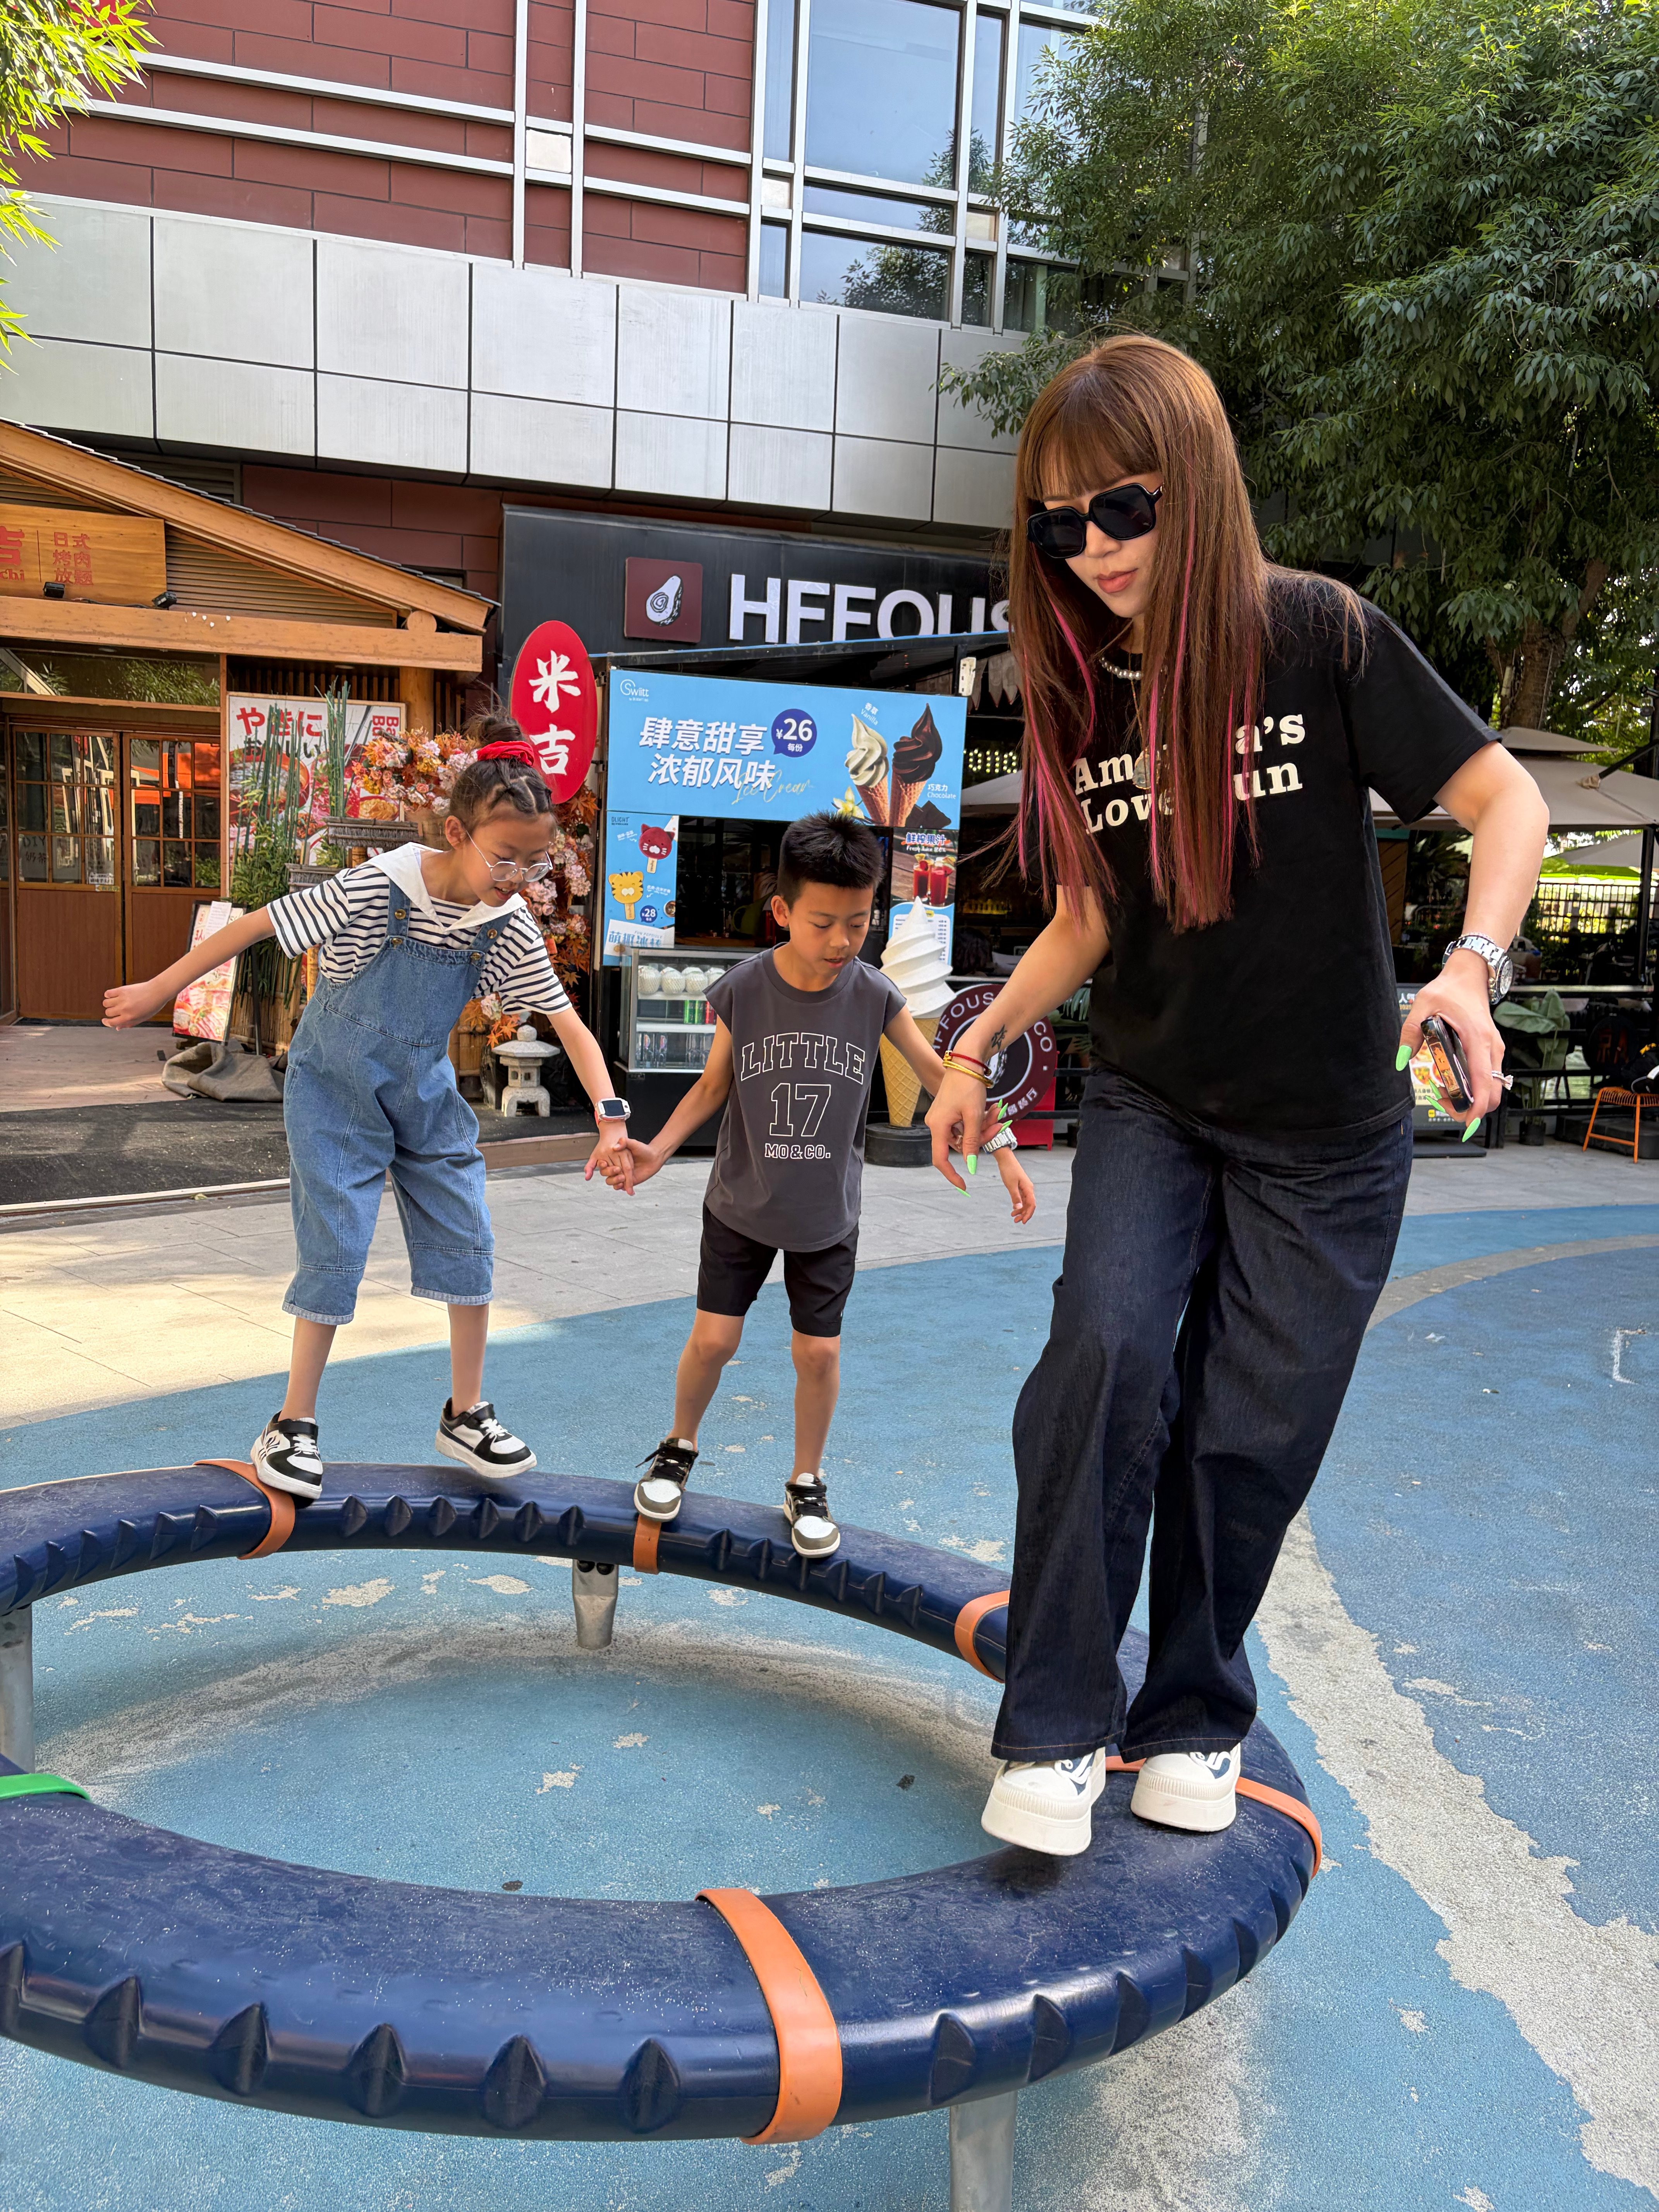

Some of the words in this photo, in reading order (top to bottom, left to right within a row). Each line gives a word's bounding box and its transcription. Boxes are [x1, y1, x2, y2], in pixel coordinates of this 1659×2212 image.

[54, 532, 91, 550] 日式
[53, 549, 91, 568] 烤肉
[54, 568, 94, 586] 放题
[529, 650, 581, 776] 米吉
[861, 708, 878, 725] Vanilla
[865, 702, 878, 715] 香草
[639, 717, 767, 756] 肆意甜享
[776, 718, 812, 741] ¥26
[787, 743, 803, 752] 每份
[648, 753, 775, 791] 浓郁风味
[1233, 763, 1303, 801] un
[906, 832, 946, 845] 鲜榨果汁
[741, 1032, 866, 1085] LITTLE
[769, 1083, 831, 1137] 17
[764, 1143, 831, 1159] MO&CO.
